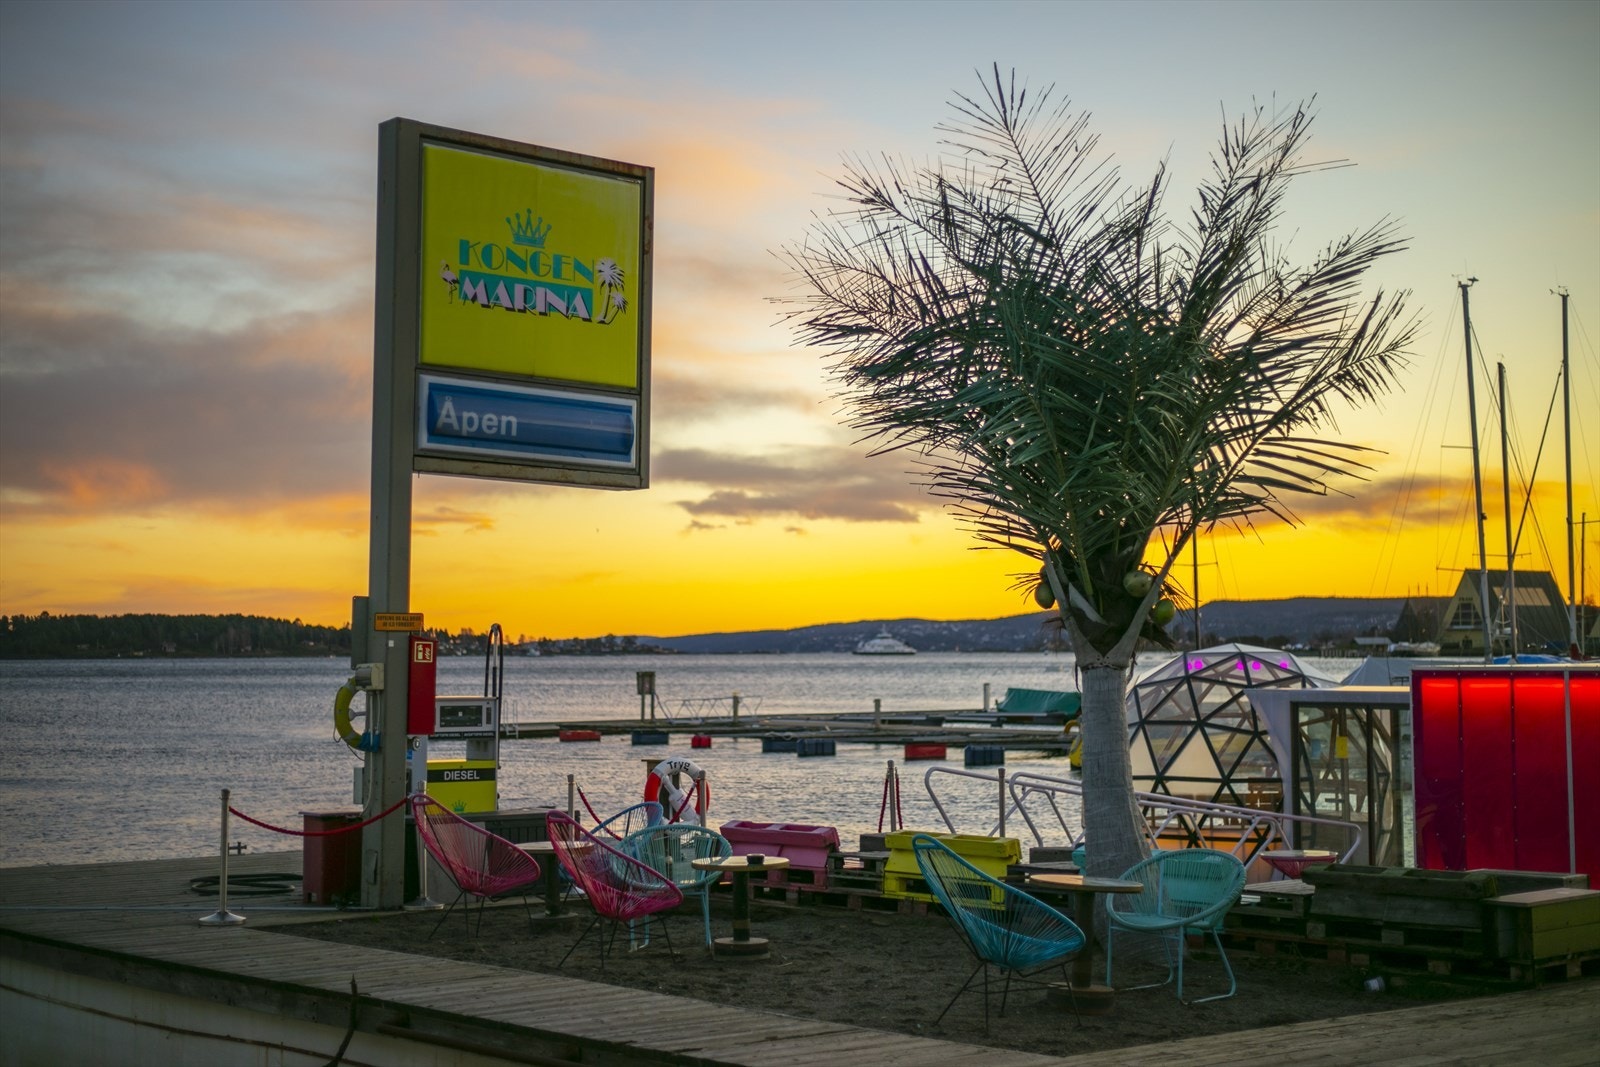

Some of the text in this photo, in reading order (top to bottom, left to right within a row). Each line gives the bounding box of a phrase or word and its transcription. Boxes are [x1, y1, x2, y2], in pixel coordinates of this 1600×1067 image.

[459, 239, 594, 284] KONGEN
[460, 276, 592, 322] MARINA
[436, 396, 518, 437] Åpen
[444, 770, 480, 780] DIESEL
[667, 761, 691, 772] Tryg
